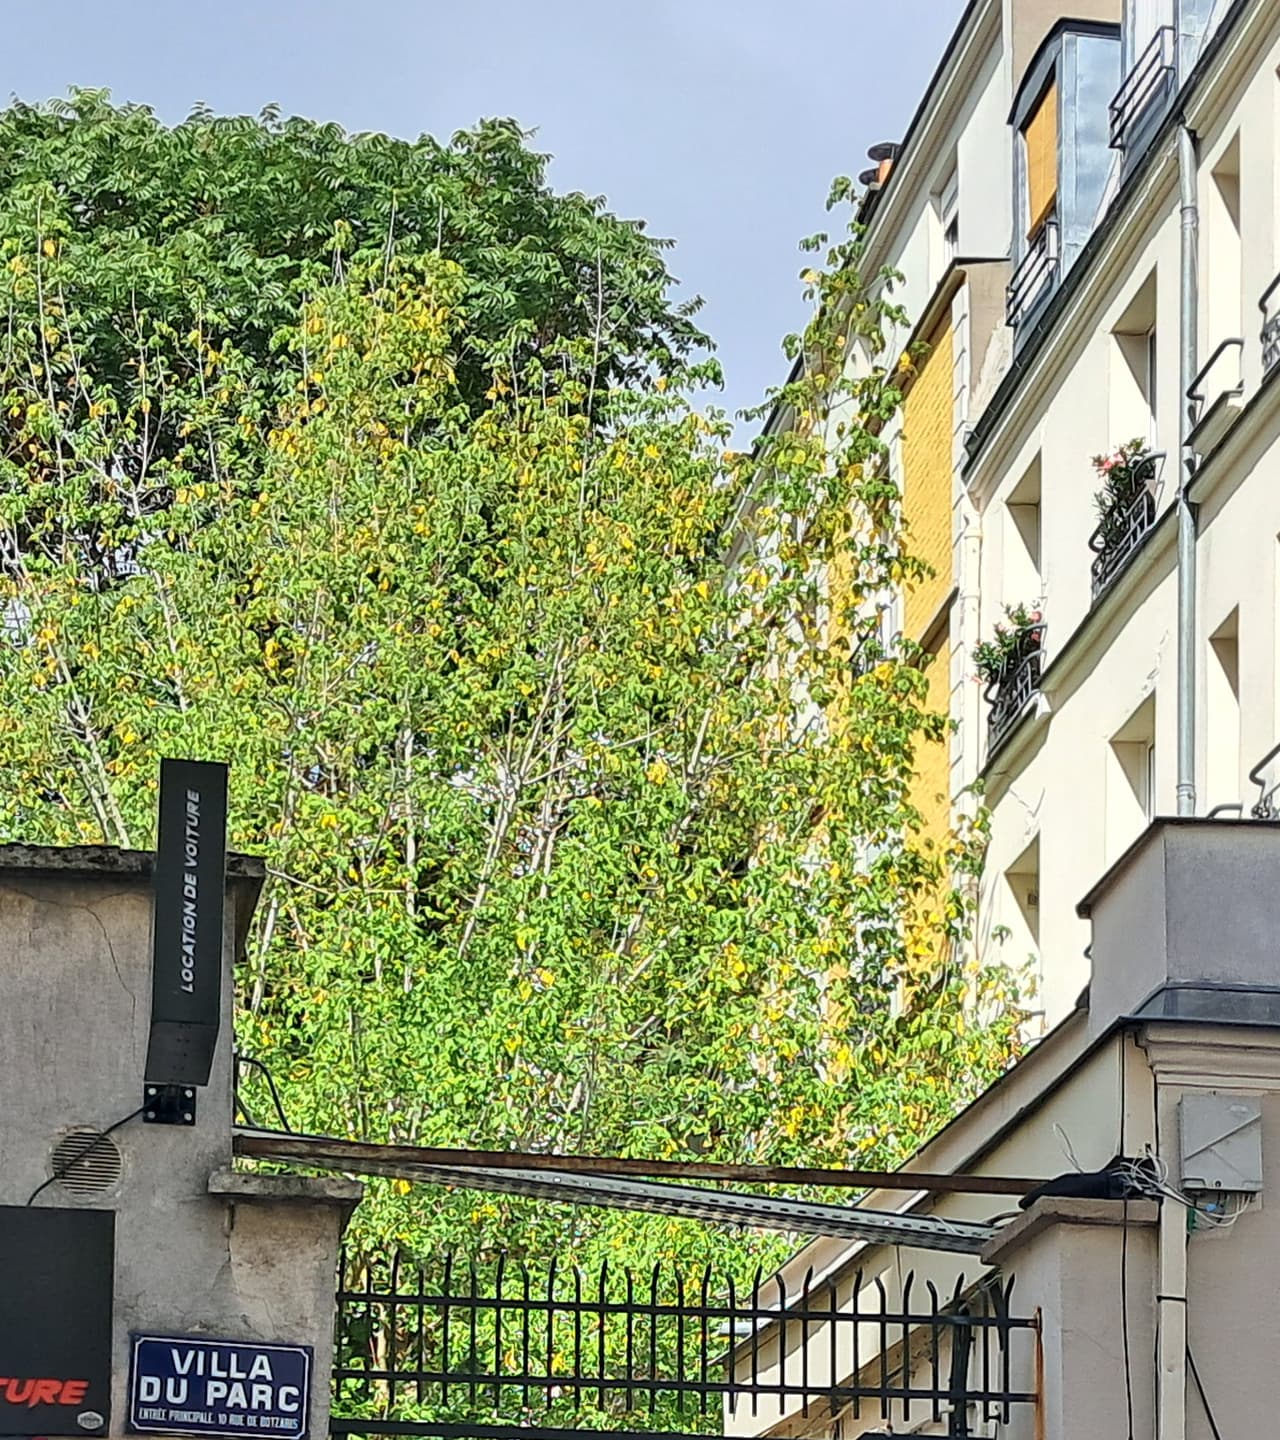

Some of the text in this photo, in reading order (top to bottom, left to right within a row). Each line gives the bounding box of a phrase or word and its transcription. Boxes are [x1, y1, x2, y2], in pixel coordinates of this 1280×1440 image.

[180, 789, 200, 993] LOCATION DE VOITURE
[170, 1349, 273, 1381] VILLA
[139, 1375, 299, 1412] DU PARC
